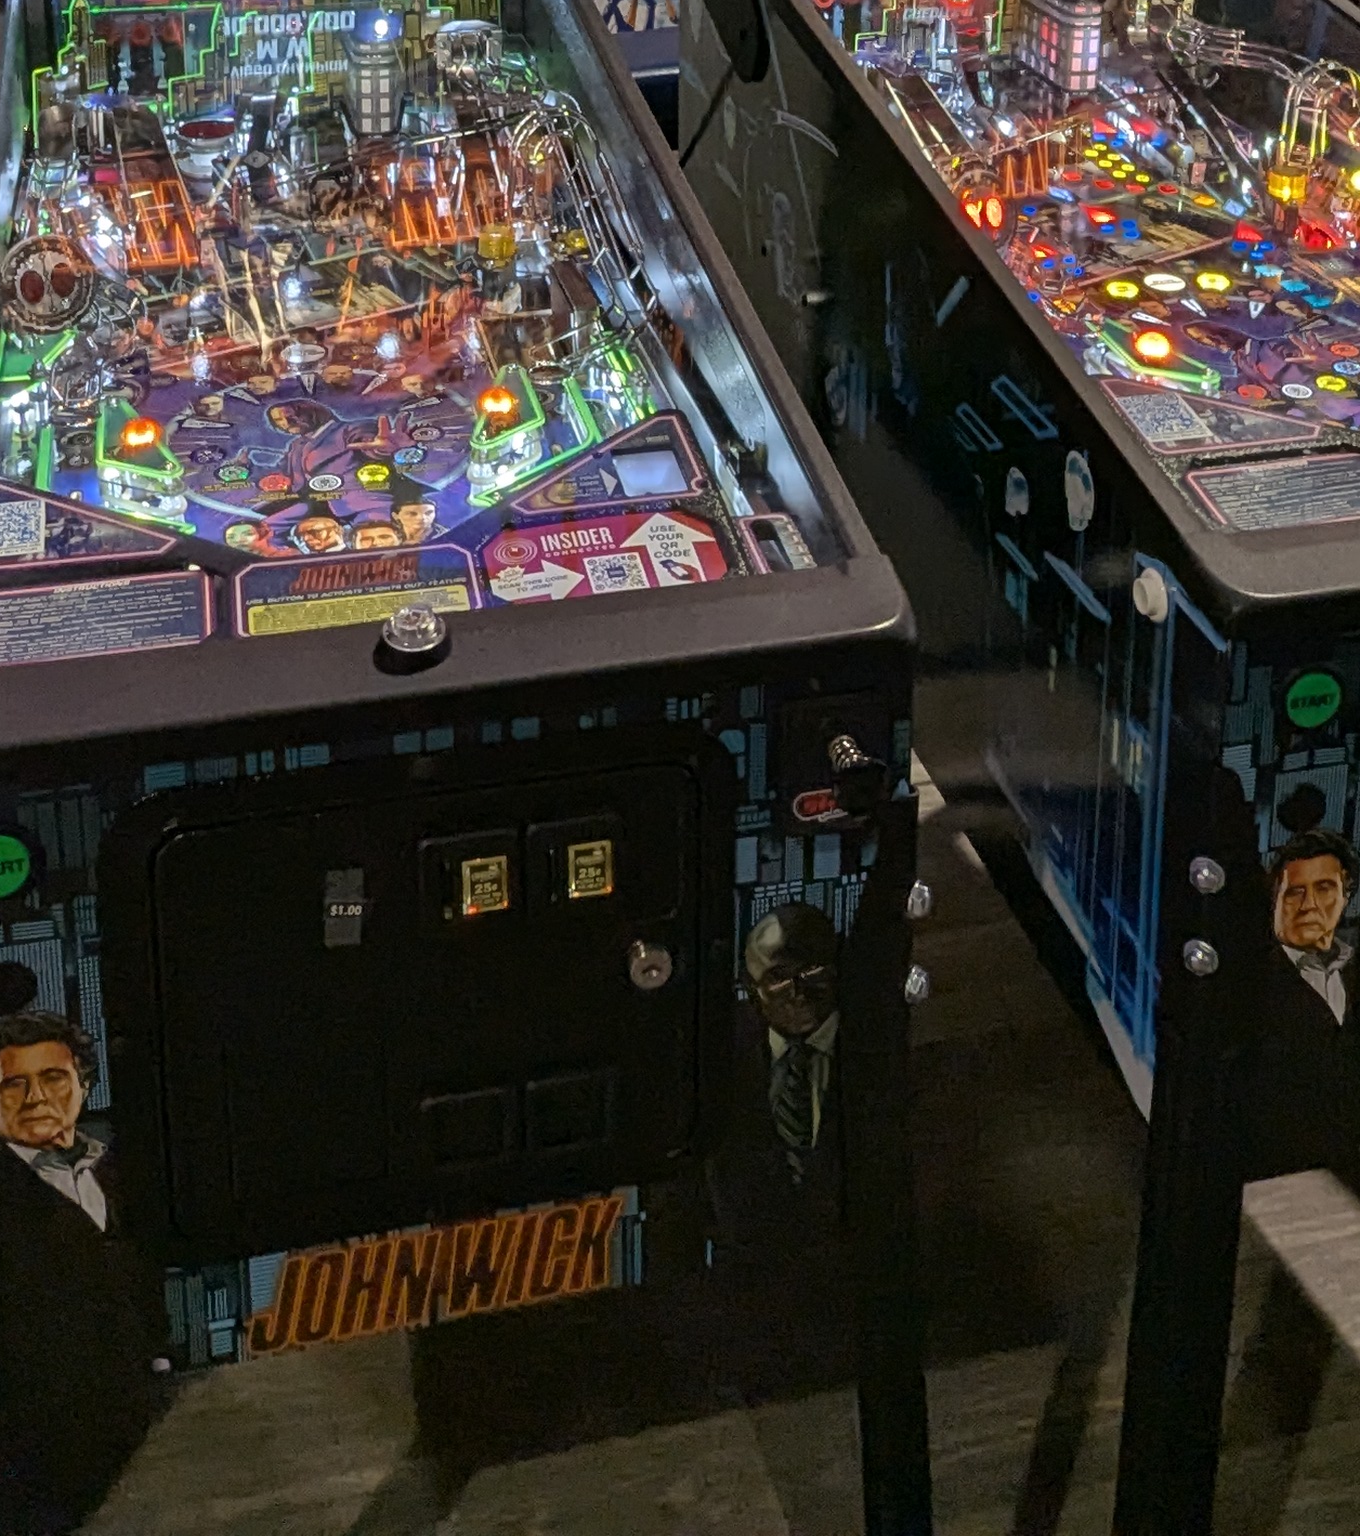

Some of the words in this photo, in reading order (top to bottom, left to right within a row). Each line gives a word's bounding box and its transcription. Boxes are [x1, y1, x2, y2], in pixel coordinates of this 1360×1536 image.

[649, 525, 676, 533] USE
[541, 526, 614, 552] INSIDER
[648, 533, 684, 542] YOUR
[545, 544, 617, 558] CONNECTED
[660, 541, 679, 550] QR
[653, 549, 691, 558] CODE
[497, 581, 522, 591] SCAN
[523, 578, 544, 586] THIS
[545, 574, 569, 584] CODE
[246, 598, 264, 606] USE
[267, 594, 304, 603] BUTTON
[307, 592, 319, 600] TO
[321, 587, 364, 597] ACTIVATE
[428, 577, 467, 586] FEATURE
[1290, 694, 1336, 712] START
[578, 867, 602, 880] 25¢
[474, 882, 498, 895] 25¢
[330, 904, 363, 917] $1.00
[251, 1227, 443, 1357] JOHN
[443, 1194, 624, 1321] WICK
